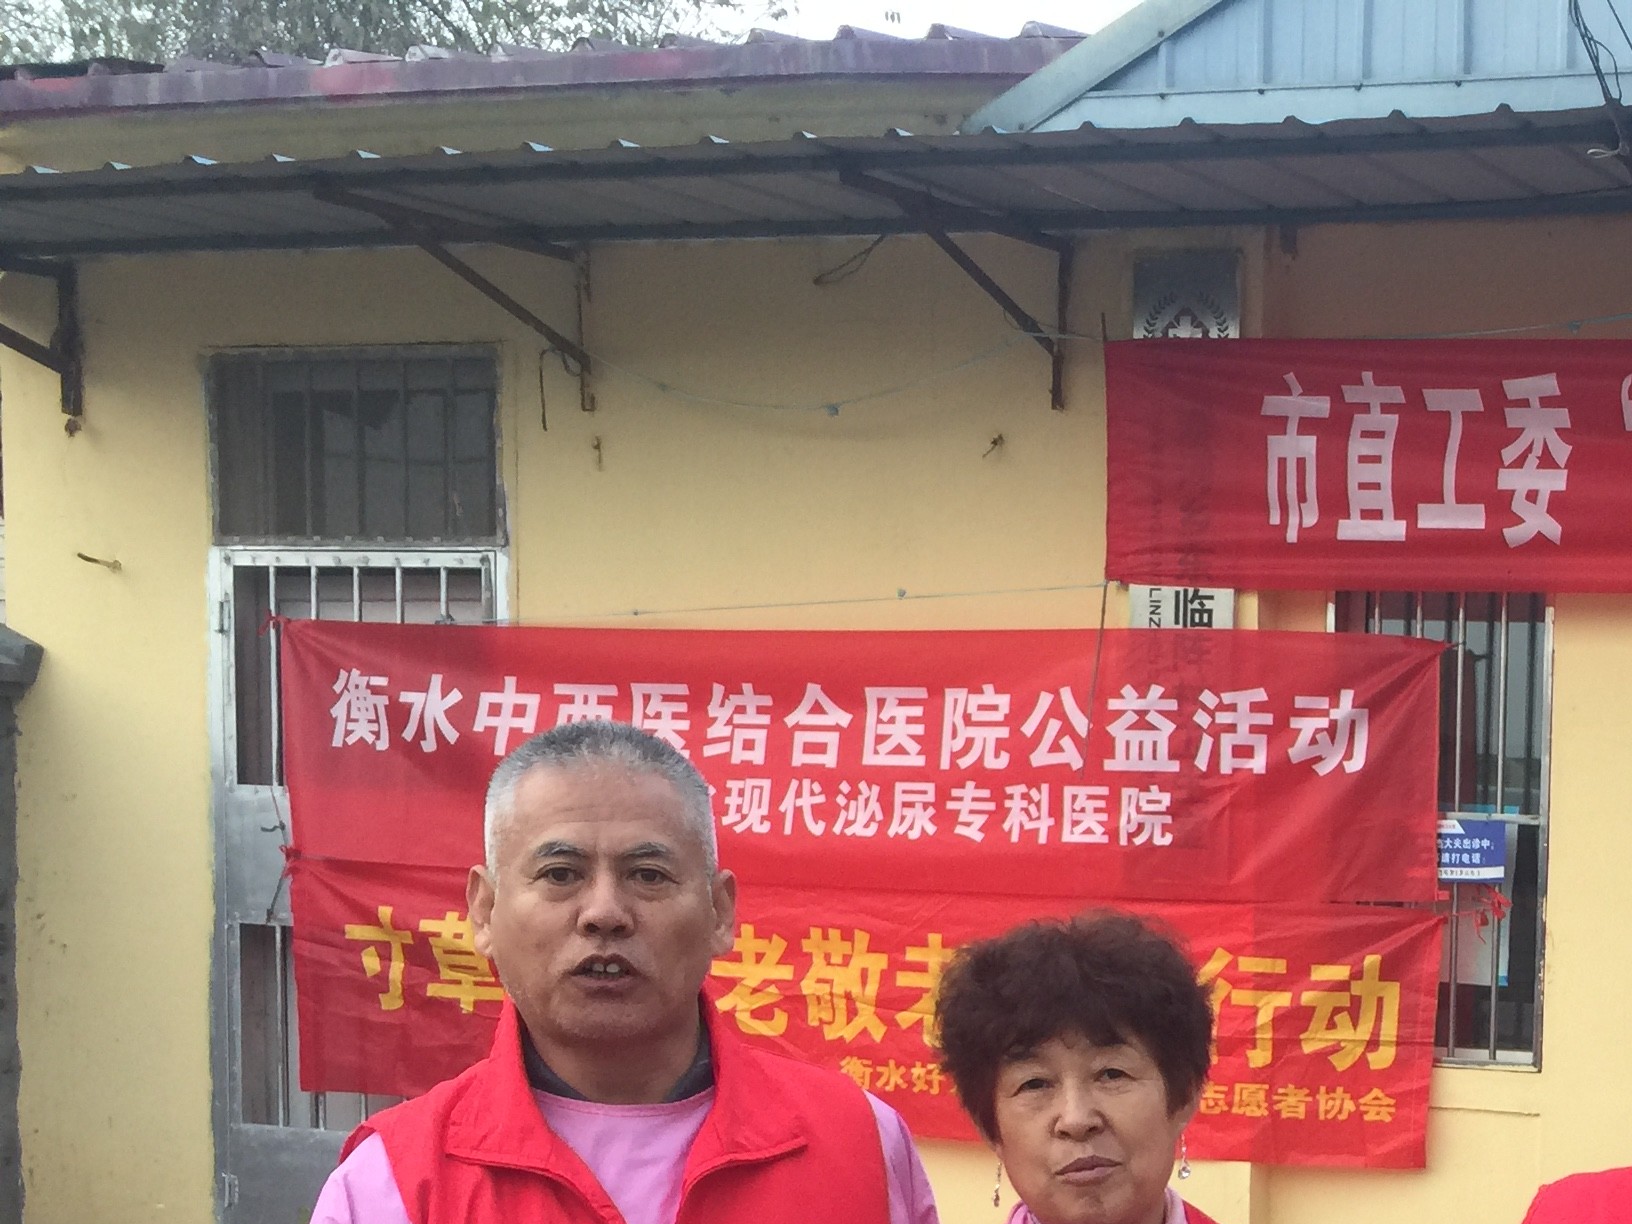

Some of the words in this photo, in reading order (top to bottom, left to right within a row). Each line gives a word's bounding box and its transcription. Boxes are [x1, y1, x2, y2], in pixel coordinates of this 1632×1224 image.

[706, 777, 1174, 846] 现代泌尿专科医院
[839, 1056, 957, 1095] 衡水好
